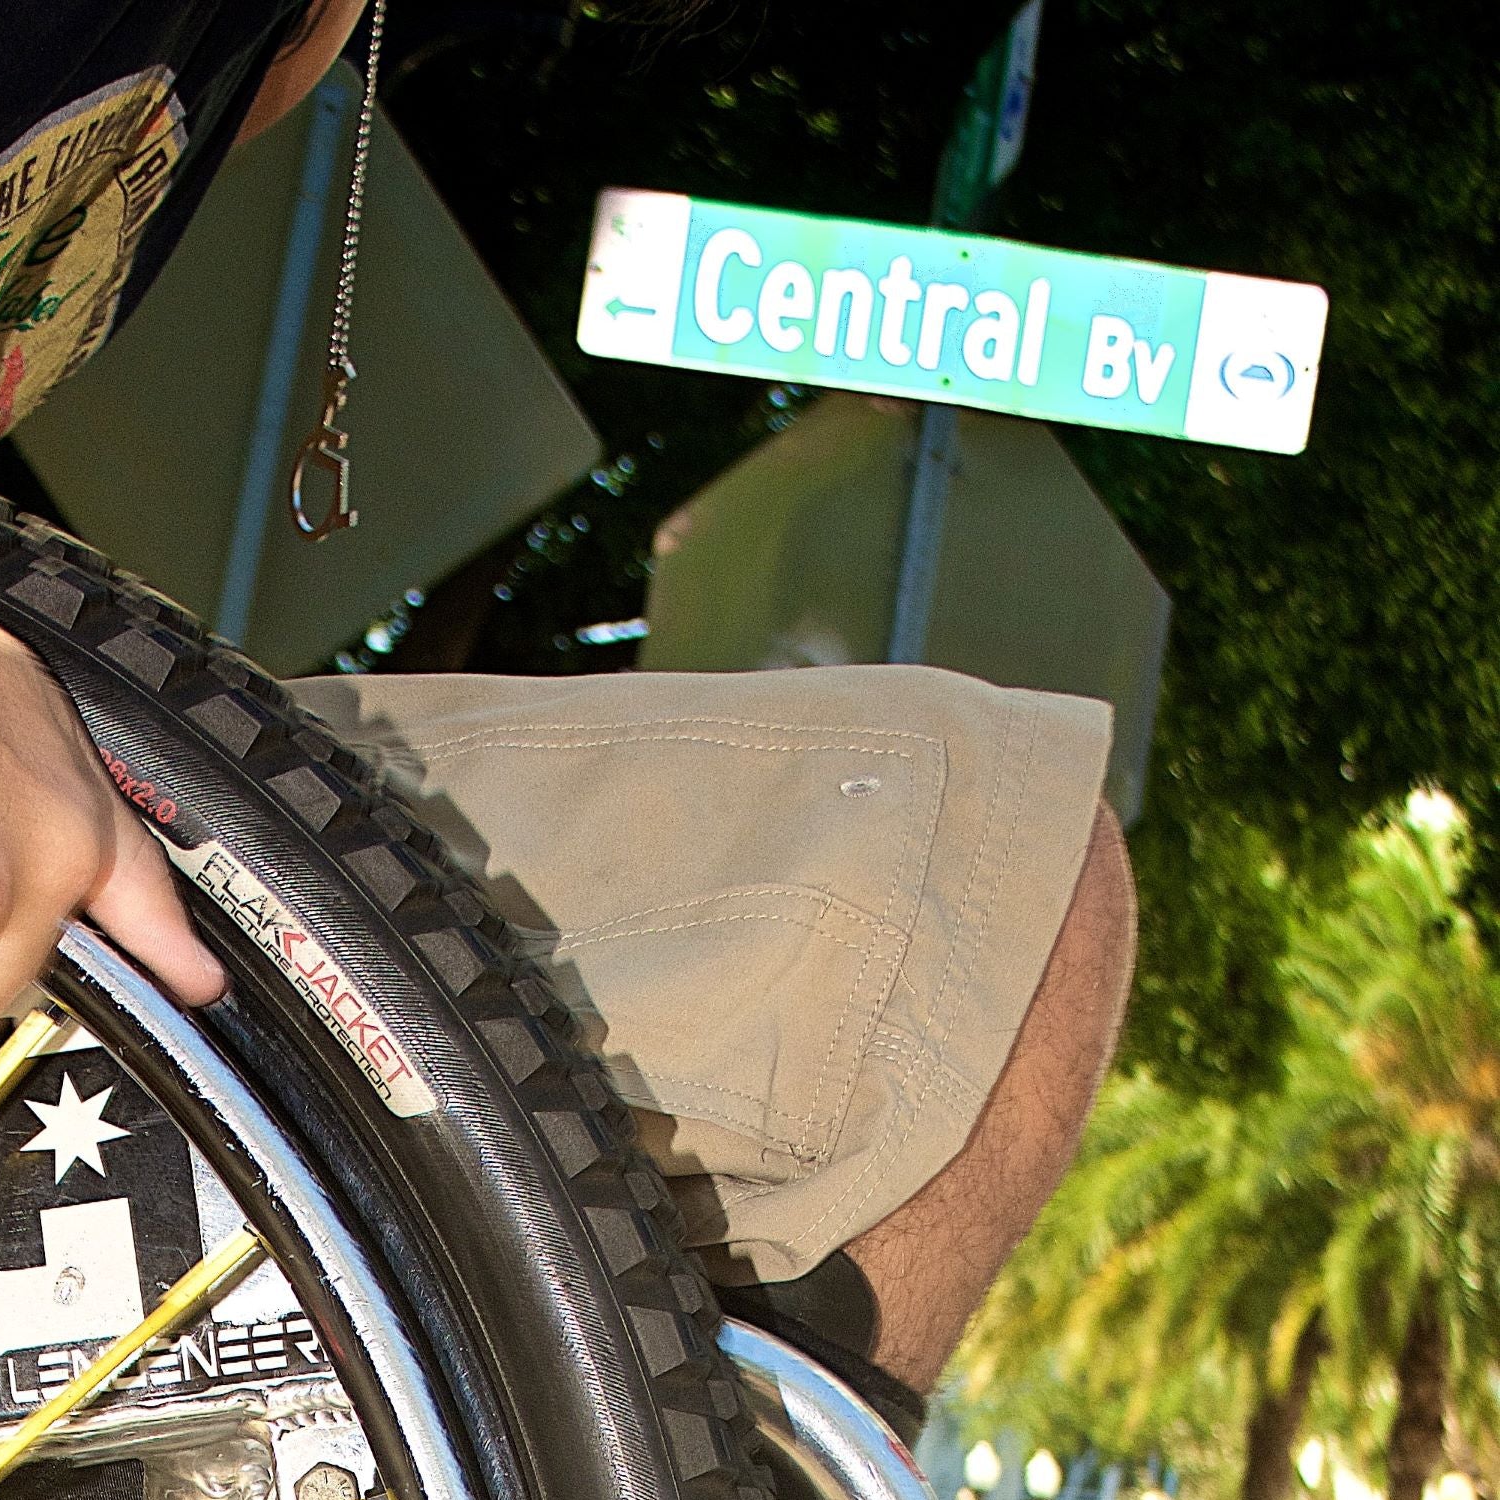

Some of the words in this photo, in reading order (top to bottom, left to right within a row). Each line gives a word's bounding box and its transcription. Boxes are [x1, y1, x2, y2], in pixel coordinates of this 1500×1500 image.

[693, 228, 1051, 386] Central
[1082, 313, 1176, 405] Bv
[196, 871, 293, 973] PUNCTURE
[295, 976, 392, 1101] PROTECTION
[203, 851, 306, 960] FLAK
[295, 960, 414, 1084] JACKET
